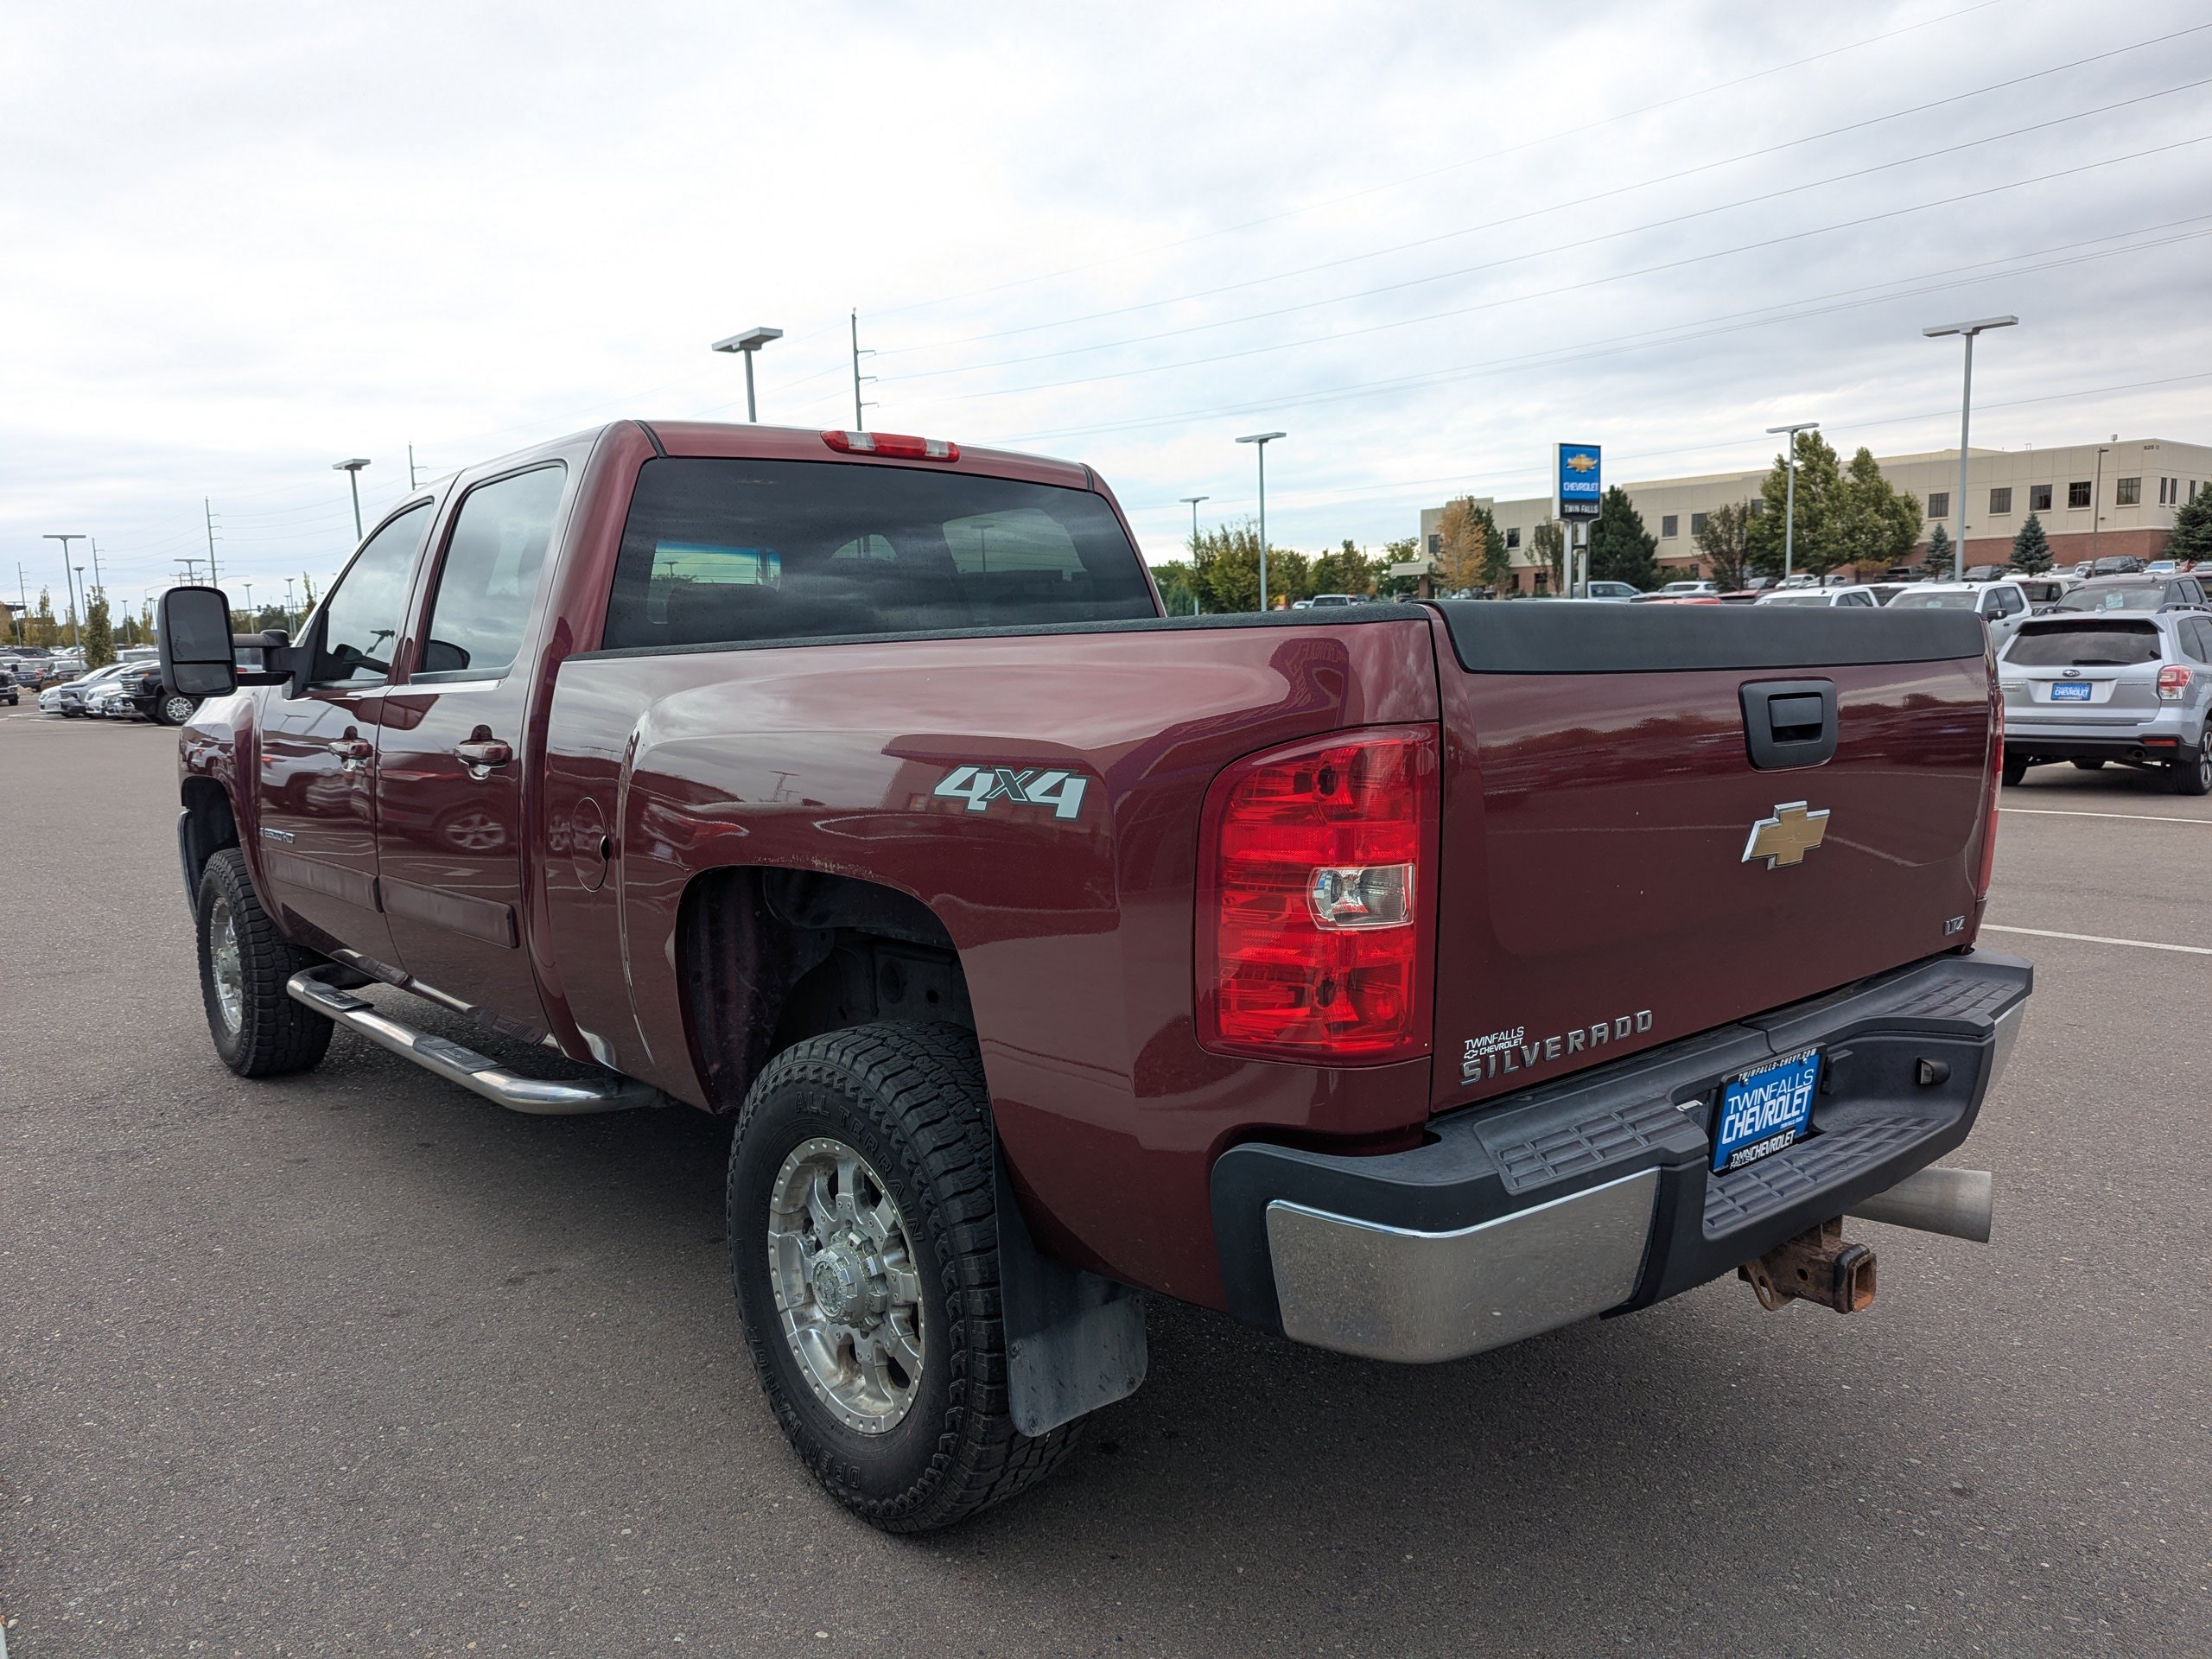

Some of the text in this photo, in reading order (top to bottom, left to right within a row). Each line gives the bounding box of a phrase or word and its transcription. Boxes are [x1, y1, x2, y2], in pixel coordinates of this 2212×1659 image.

[1563, 482, 1599, 492] CHEVROLET
[1581, 505, 1599, 514] FALLS
[1944, 916, 1965, 936] LTZ
[1460, 1009, 1652, 1086] SILVERADO
[1464, 1026, 1524, 1051] TWINFALLS
[1479, 1038, 1523, 1056] CHEVROLET
[1728, 1069, 1815, 1115] TWINFALLS
[1722, 1084, 1812, 1145] CHEVROLET
[1732, 1147, 1751, 1162] TWIN
[1750, 1129, 1796, 1161] CHEVROLET
[795, 1090, 925, 1243] ALL TERRAIN
[1729, 1155, 1751, 1170] FALLS
[806, 1436, 861, 1489] OPEN
